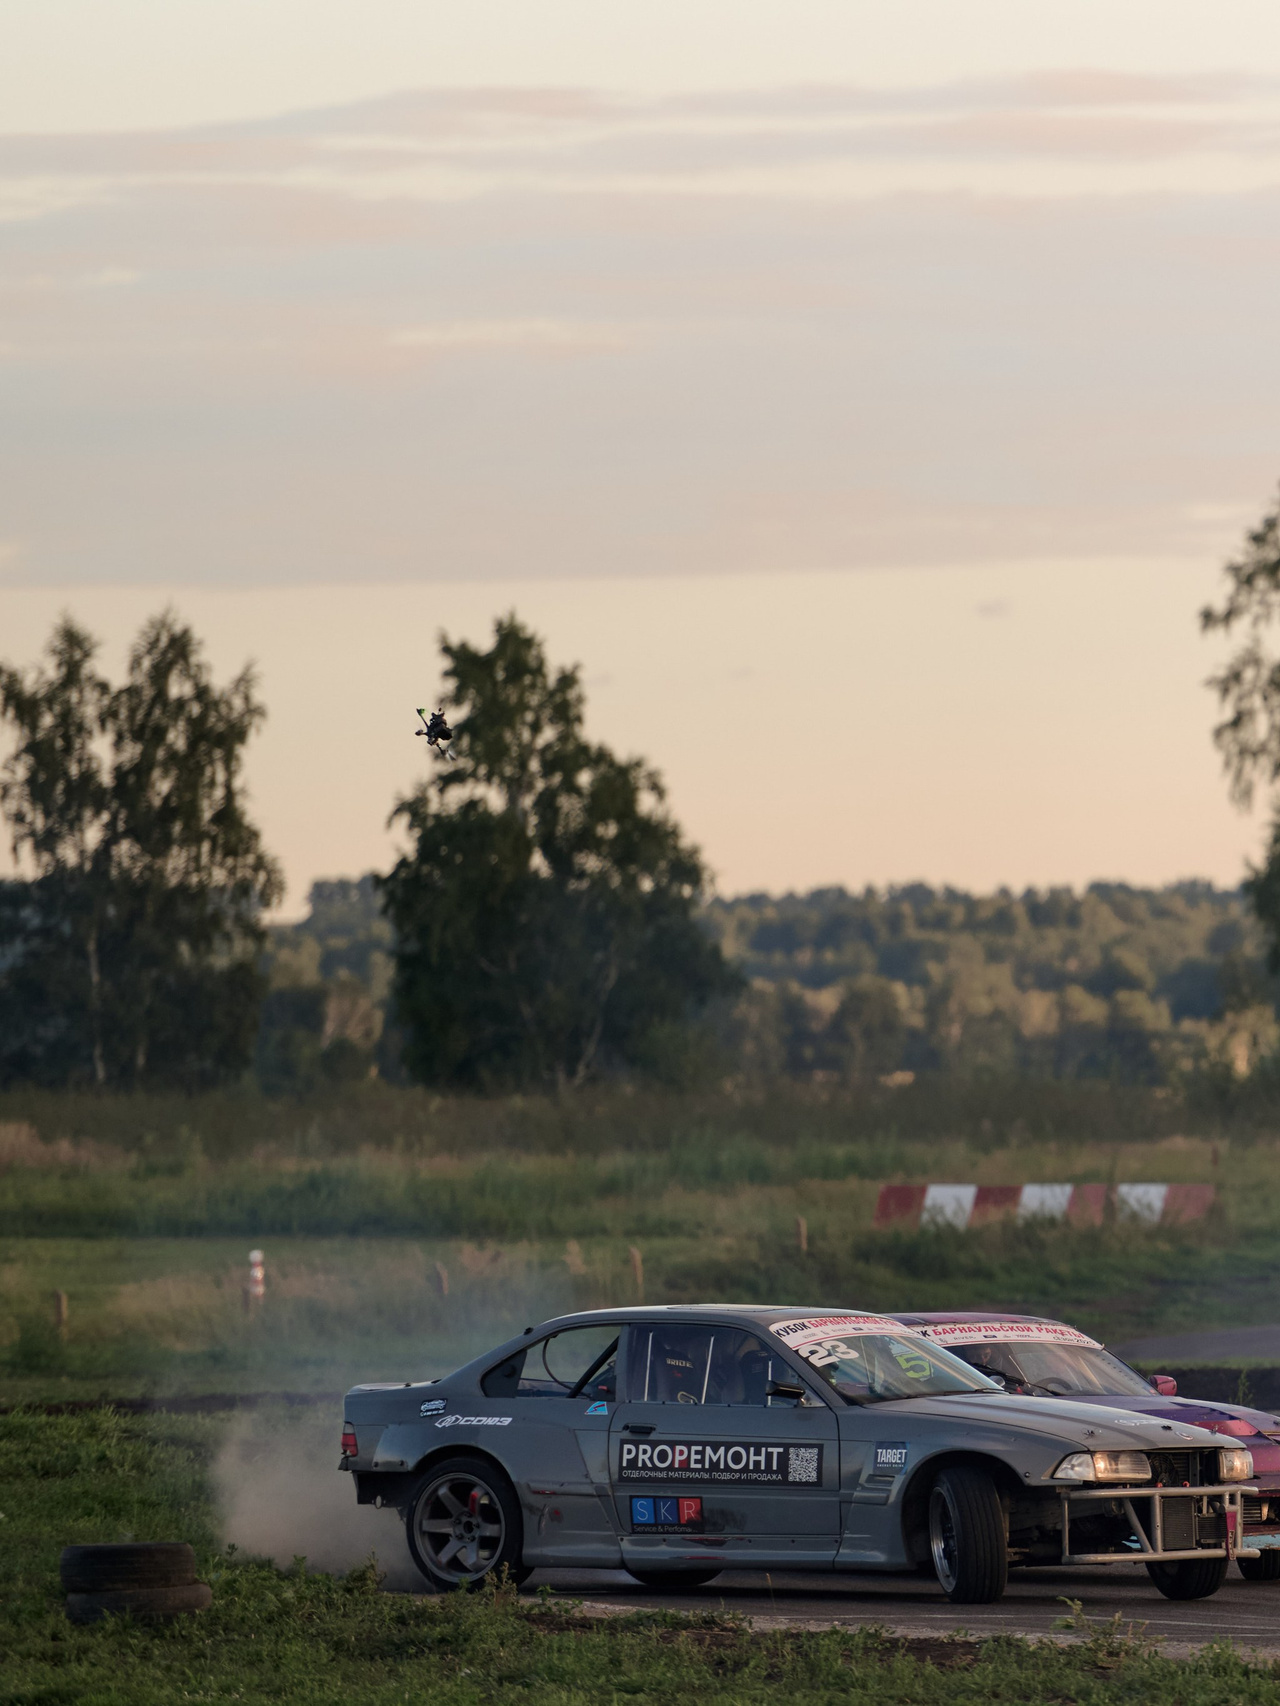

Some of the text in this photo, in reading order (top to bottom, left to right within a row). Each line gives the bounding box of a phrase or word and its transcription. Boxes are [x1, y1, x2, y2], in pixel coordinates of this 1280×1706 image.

[774, 1322, 811, 1338] КУБОК
[932, 1325, 1034, 1336] БАРНАУЛЬСКОЙ
[1036, 1326, 1085, 1339] РАКЕТЫ
[798, 1340, 859, 1367] 23
[895, 1352, 931, 1379] 5
[876, 1449, 907, 1463] TARGET
[622, 1470, 668, 1479] ОТДЕЛОЧНЫЕ
[668, 1471, 711, 1480] МАТЕРИАЛЫ.
[711, 1472, 741, 1481] ПОДБОР
[747, 1473, 783, 1482] ПРОДАЖА
[636, 1500, 697, 1521] SKR
[633, 1525, 657, 1533] Service
[658, 1525, 664, 1533] &
